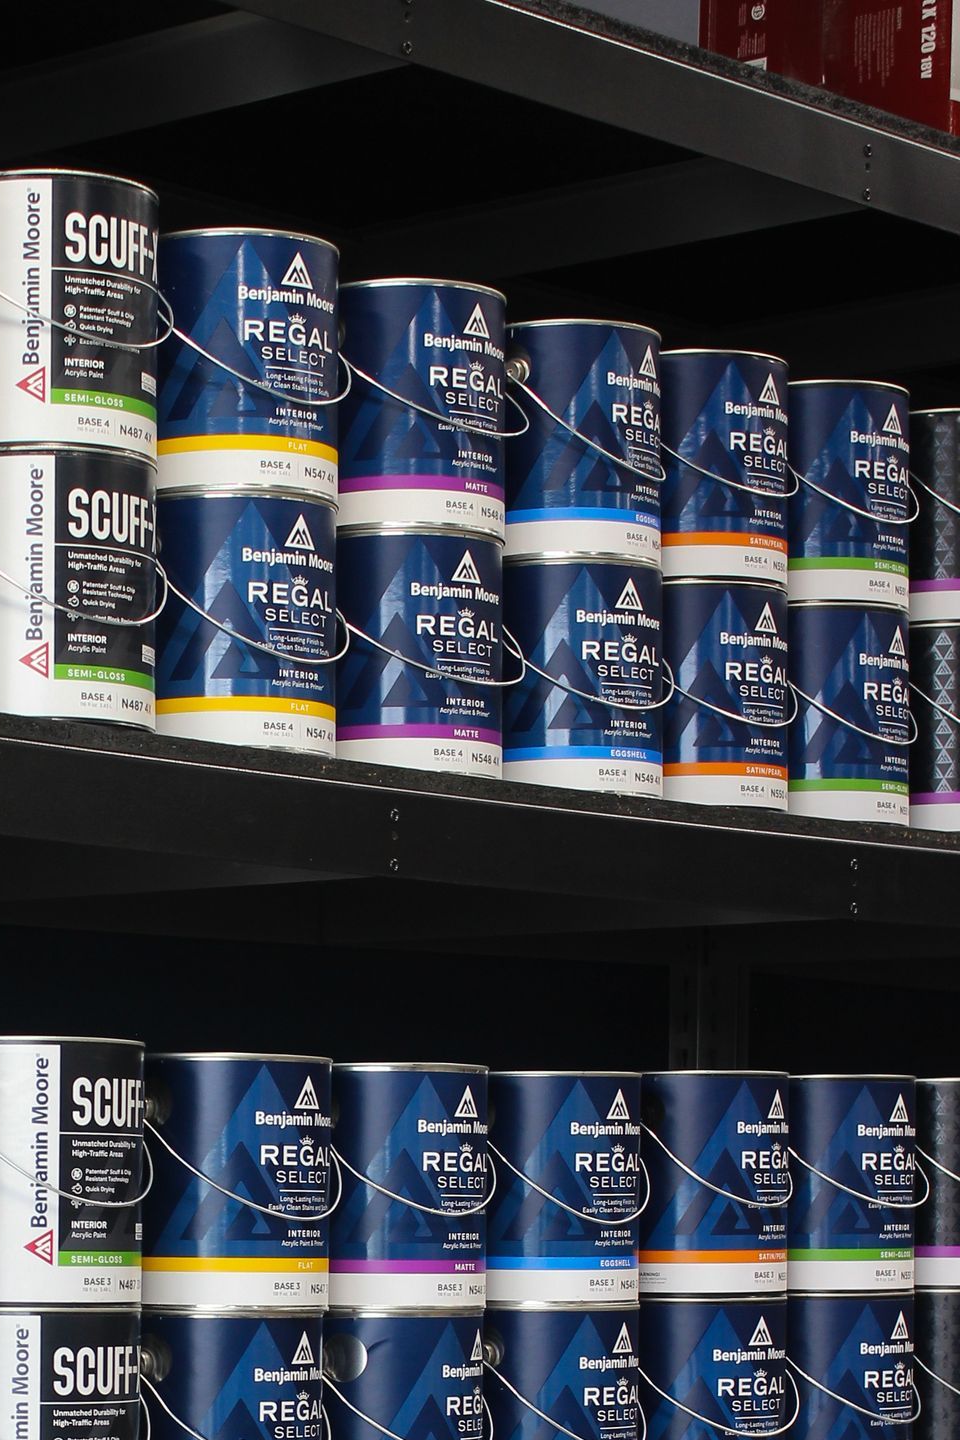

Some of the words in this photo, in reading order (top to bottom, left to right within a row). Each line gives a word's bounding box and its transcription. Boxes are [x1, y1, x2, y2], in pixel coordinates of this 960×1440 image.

[921, 24, 936, 53] 120
[238, 285, 304, 305] Benjamin
[307, 293, 334, 313] Moore
[244, 318, 332, 353] REGAL
[64, 357, 105, 369] INTERIOR
[261, 346, 326, 368] SELECT
[429, 366, 503, 399] REGAL
[64, 393, 124, 408] SEMI-GLOSS
[445, 391, 498, 413] SELECT
[725, 402, 773, 418] Benjamin
[288, 441, 308, 451] FLAT
[465, 482, 488, 492] MATTE
[754, 509, 781, 520] INTERIOR
[626, 532, 643, 540] BASE
[68, 563, 105, 573] High-Traffic
[107, 565, 127, 575] Areas
[248, 582, 332, 613] REGAL
[410, 582, 472, 602] Benjamin
[475, 588, 499, 605] Moore
[416, 614, 498, 643] REGAL
[859, 653, 901, 670] Benjamin
[67, 668, 126, 682] SEMI-GLOSS
[597, 665, 654, 681] SELECT
[291, 703, 310, 712] FLAT
[263, 722, 286, 731] BASE
[288, 723, 293, 732] 4
[454, 729, 479, 738] MATTE
[751, 738, 780, 748] INTERIOR
[610, 750, 647, 760] EGGSHELL
[746, 767, 782, 777] SATIN/PEARL
[877, 801, 891, 810] BASE
[31, 1058, 49, 1123] Moore
[737, 1122, 780, 1137] Benjamin
[260, 1144, 329, 1167] REGAL
[31, 1132, 50, 1228] Benjamin
[437, 1176, 484, 1189] SELECT
[600, 1230, 630, 1238] INTERIOR
[884, 1224, 910, 1232] INTERIOR
[71, 1254, 122, 1264] SEMI-GLOSS
[297, 1261, 313, 1269] FLAT
[600, 1259, 630, 1268] EGGSHELL
[860, 1342, 903, 1356] Benjamin
[717, 1376, 784, 1397] REGAL
